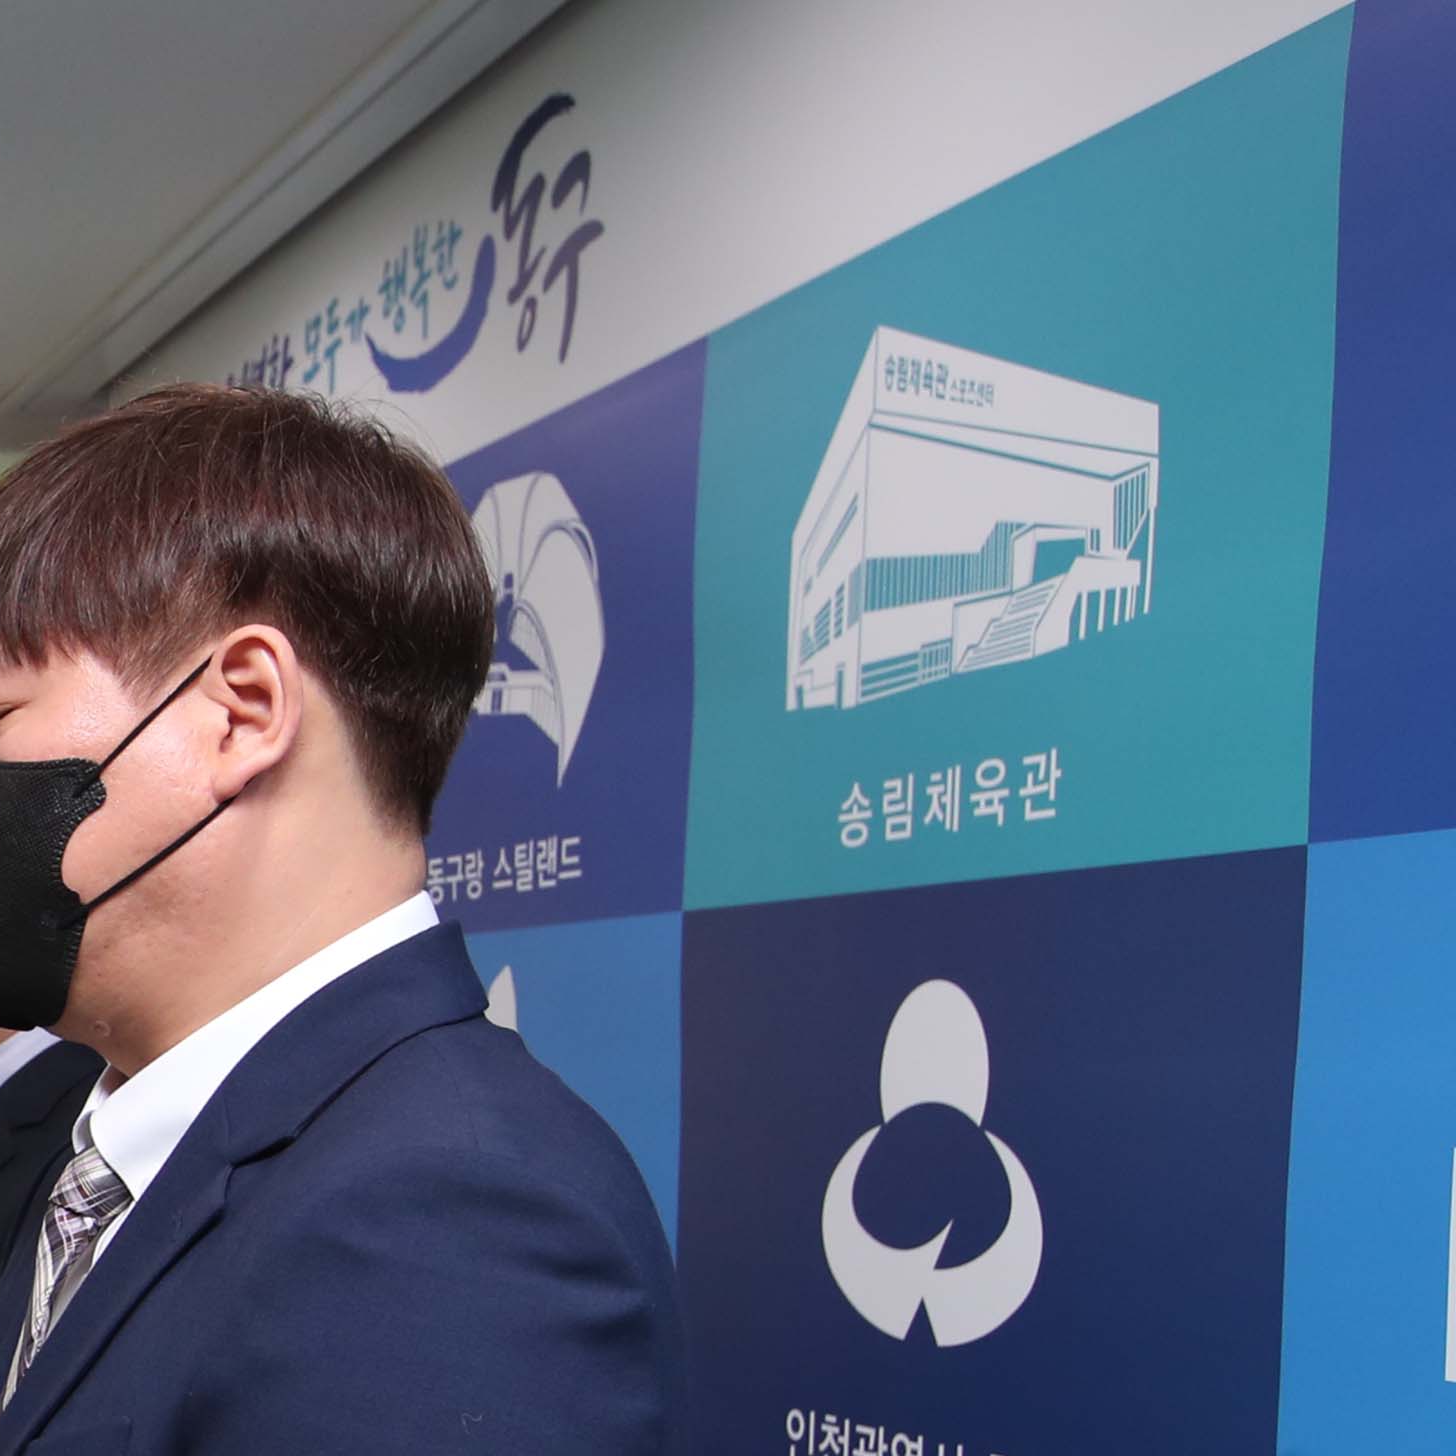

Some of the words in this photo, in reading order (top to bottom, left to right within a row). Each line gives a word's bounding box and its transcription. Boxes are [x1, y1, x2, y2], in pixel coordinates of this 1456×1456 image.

[303, 297, 371, 394] 모두가
[378, 219, 464, 340] 행복한
[490, 94, 604, 363] 동구
[837, 747, 1063, 849] 송림체육관
[426, 849, 484, 905] 동구랑
[492, 834, 582, 893] 스틸랜드
